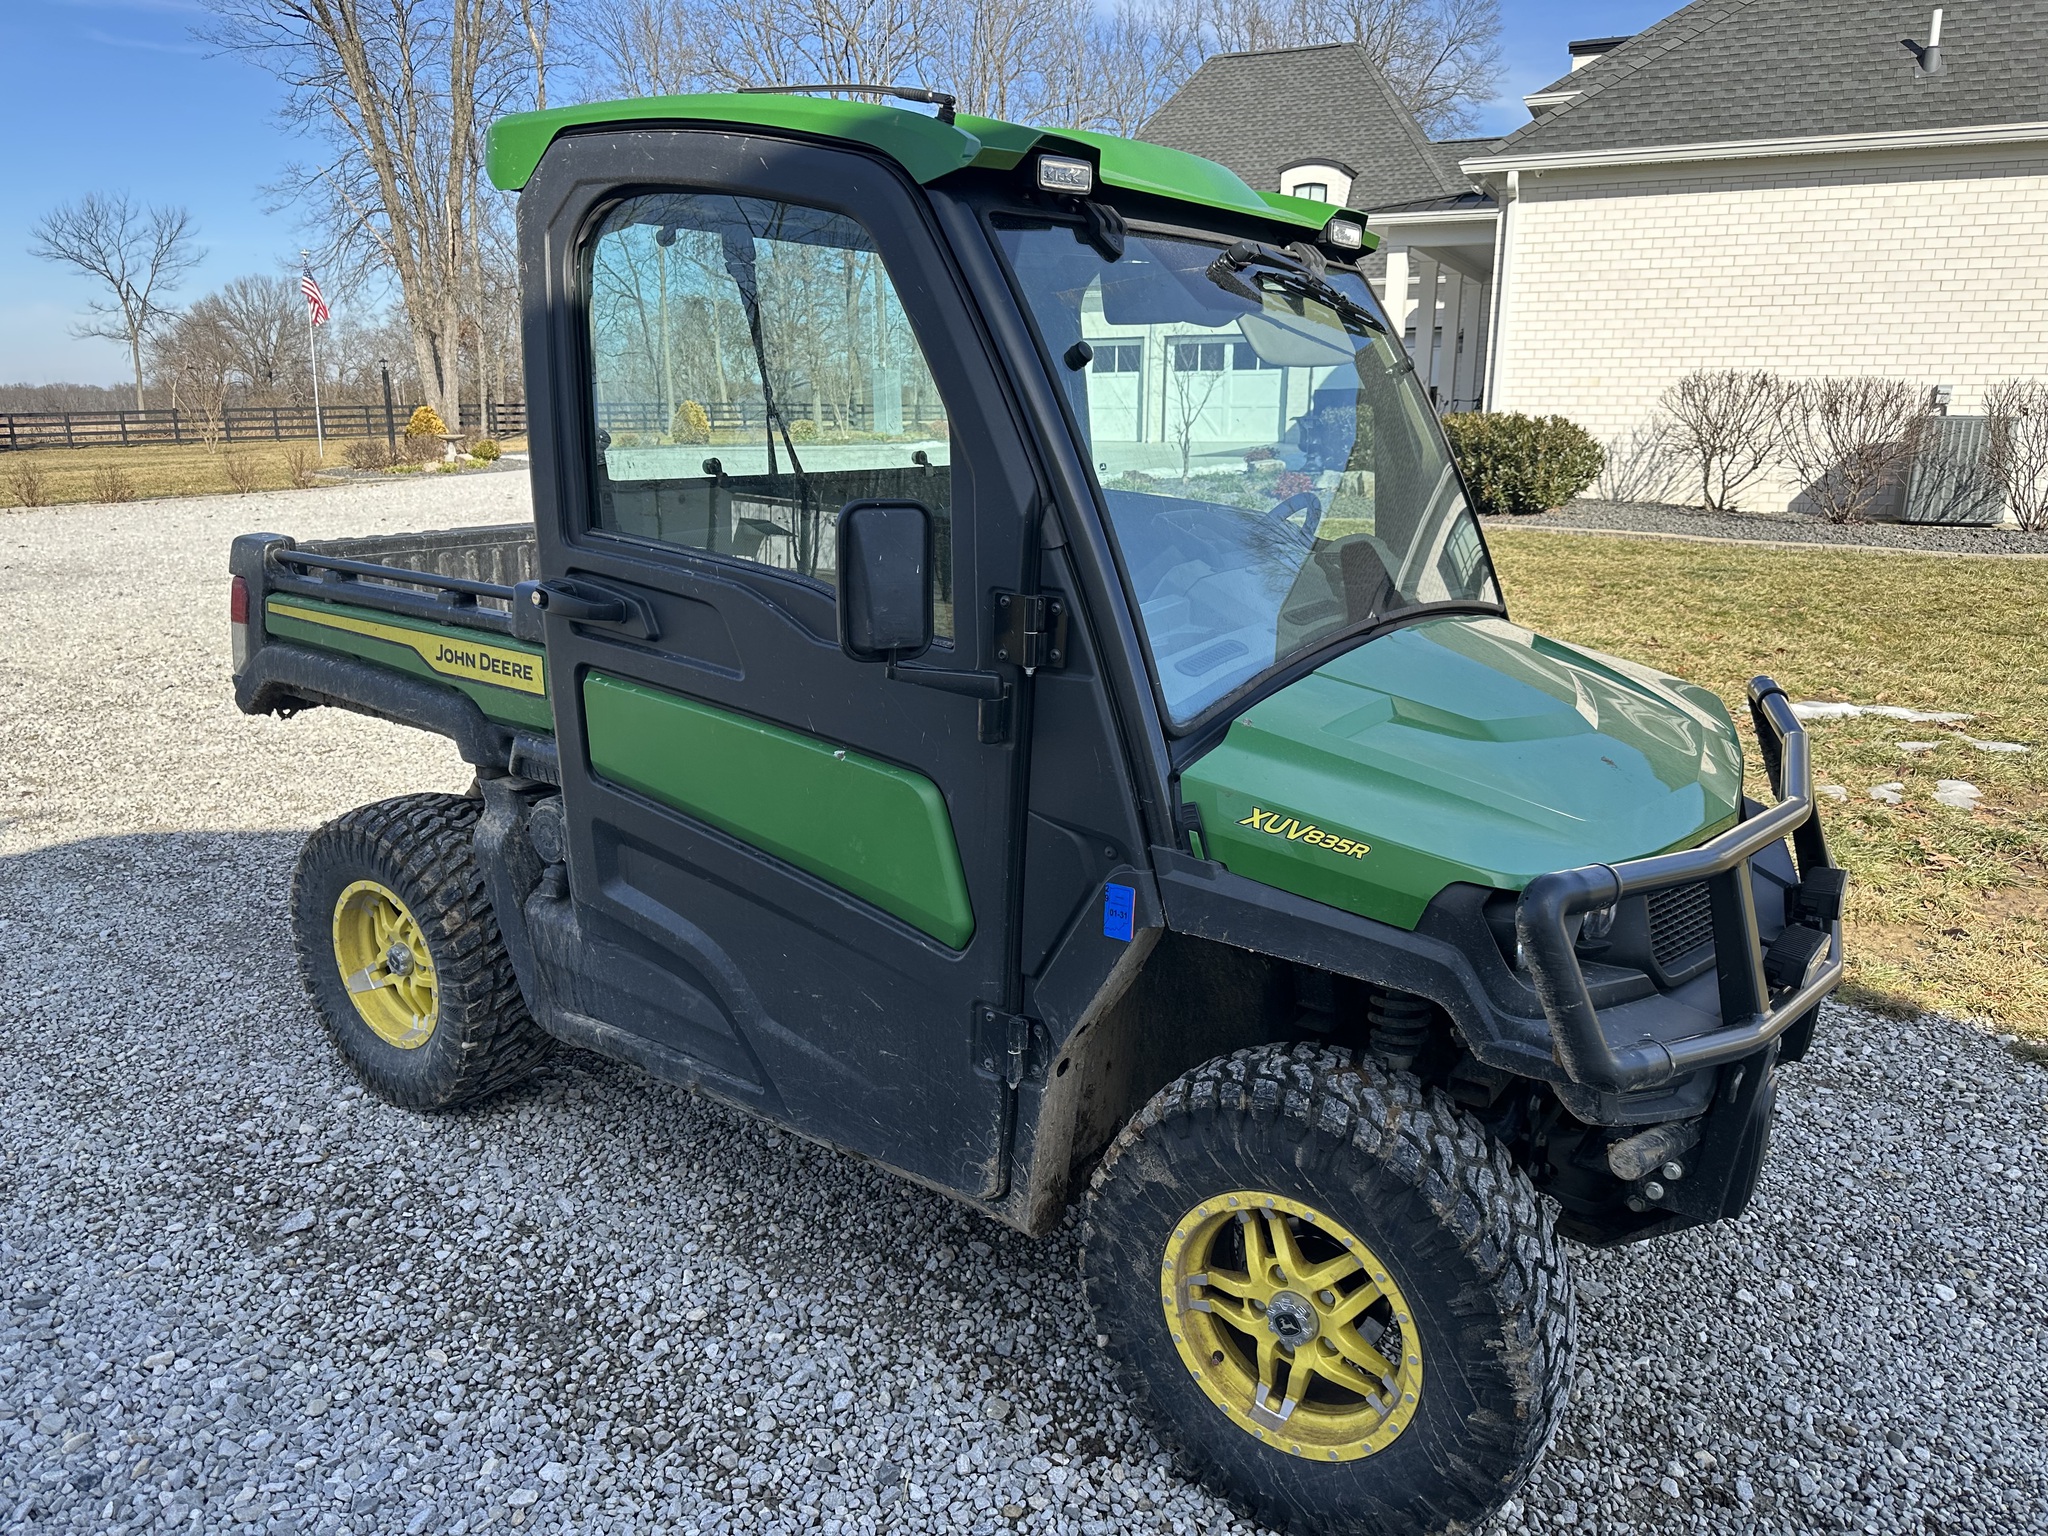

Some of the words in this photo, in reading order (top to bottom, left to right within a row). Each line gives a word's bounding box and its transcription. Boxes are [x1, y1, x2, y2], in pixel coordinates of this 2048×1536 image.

[435, 643, 476, 668] JOHN
[480, 652, 533, 681] DEERE
[1235, 806, 1372, 860] XUV835R
